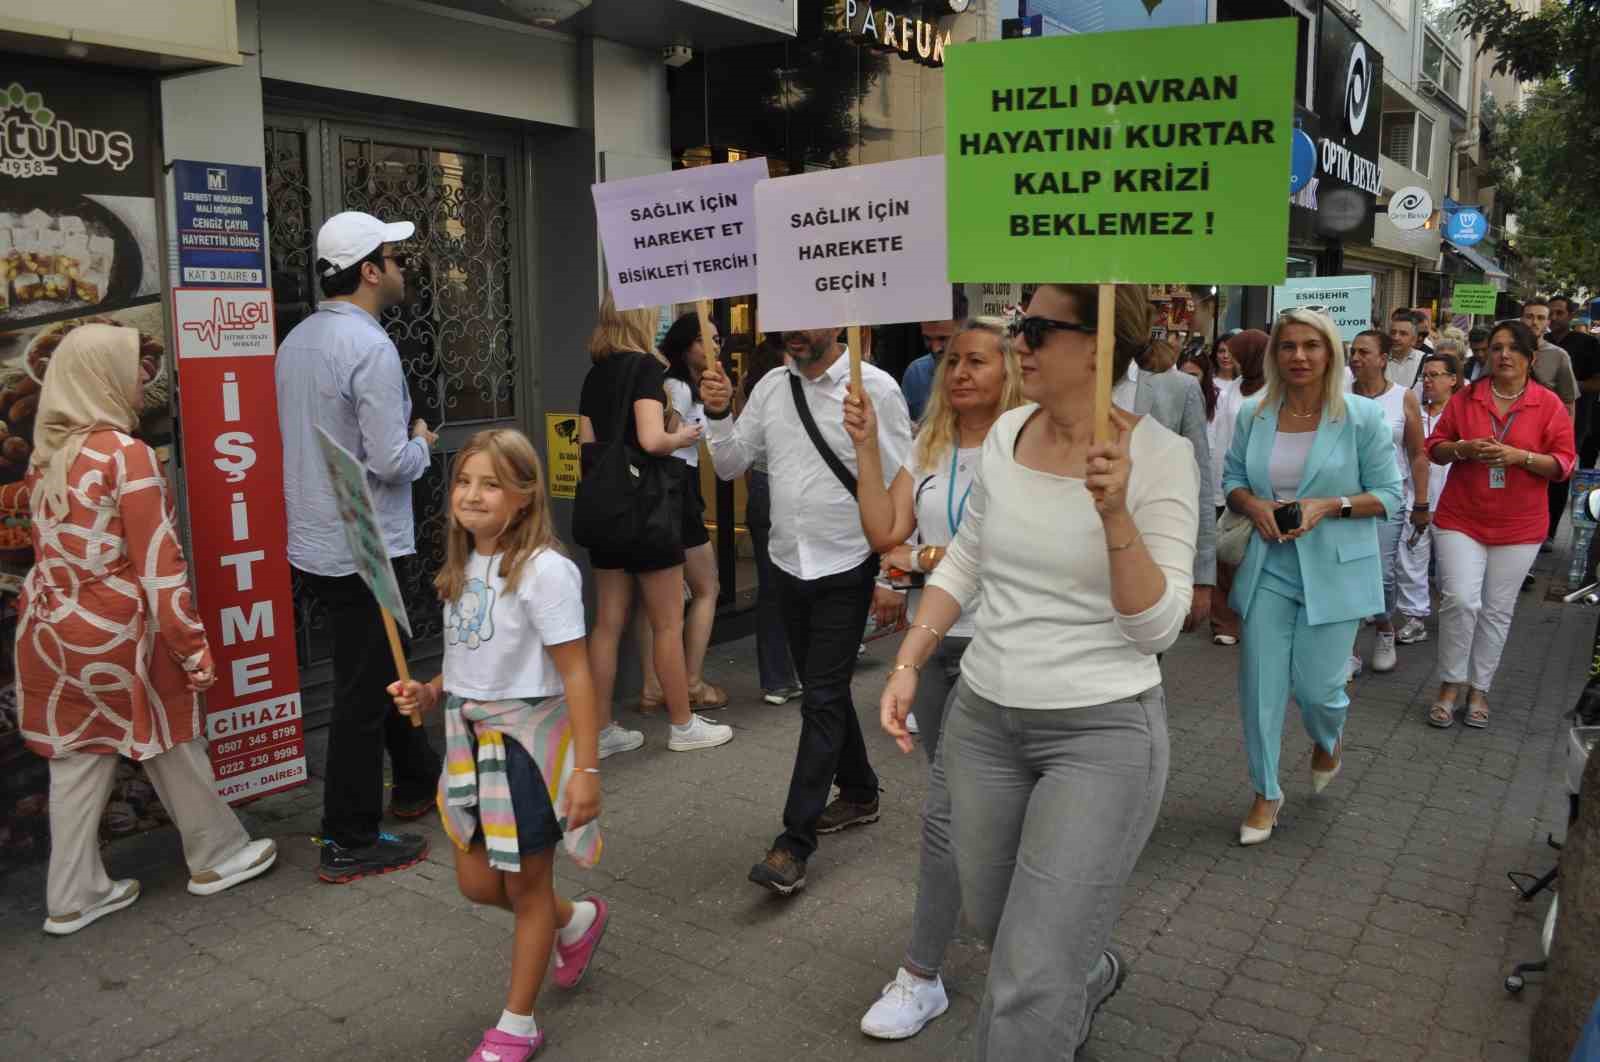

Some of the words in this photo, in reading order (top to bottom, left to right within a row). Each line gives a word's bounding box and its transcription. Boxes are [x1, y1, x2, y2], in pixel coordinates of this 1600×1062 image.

[992, 85, 1077, 112] HIZLI
[1092, 75, 1237, 106] DAVRAN
[960, 127, 1111, 155] HAYATINI
[1126, 120, 1275, 148] KURTAR
[1015, 171, 1100, 195] KALP
[1114, 161, 1208, 192] KRİZİ
[631, 201, 695, 222] SAĞLIK
[700, 193, 738, 213] İÇİN
[791, 207, 861, 228] SAĞLIK
[868, 199, 909, 222] İÇİN
[634, 226, 715, 249] HAREKET
[722, 222, 743, 236] ET
[1010, 212, 1192, 236] BEKLEMEZ
[1206, 212, 1214, 235] !
[799, 236, 903, 261] HAREKETE
[189, 270, 206, 280] KAT
[209, 271, 217, 280] 3
[618, 260, 688, 284] BİSİKLETİ
[693, 253, 748, 274] TERCİH
[816, 271, 875, 292] GEÇİN
[881, 271, 887, 287] !
[213, 372, 275, 697] İŞİTME
[214, 701, 296, 734] CİHAZI
[217, 740, 242, 755] 0507
[248, 733, 267, 747] 345
[272, 725, 296, 740] 8799
[219, 761, 245, 776] 0222
